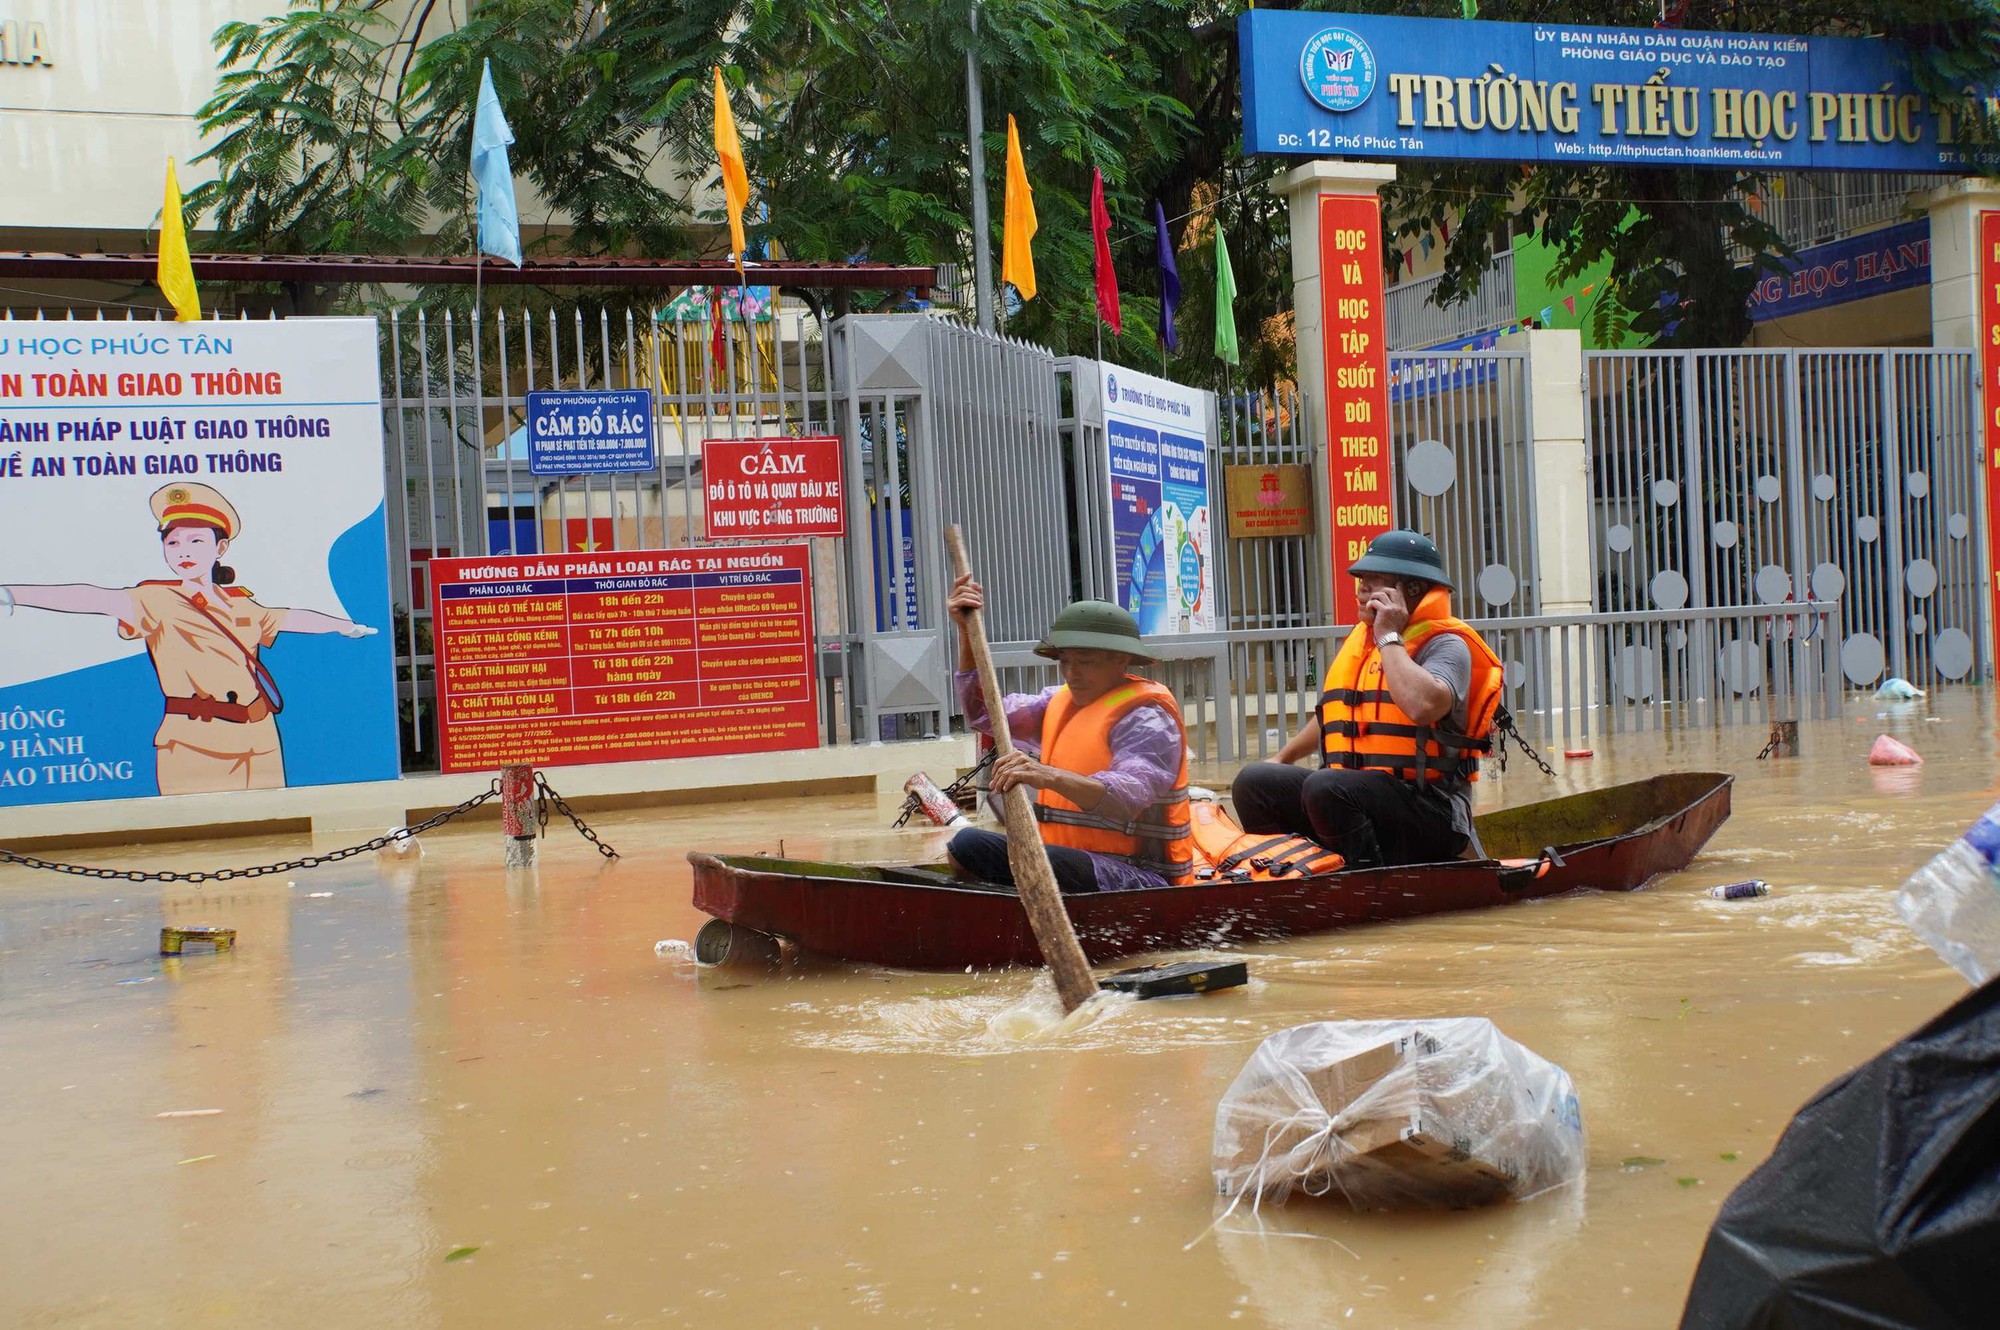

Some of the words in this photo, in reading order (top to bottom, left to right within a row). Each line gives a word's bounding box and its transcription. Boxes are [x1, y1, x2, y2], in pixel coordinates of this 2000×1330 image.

[1535, 26, 1556, 42] ỦY
[1561, 32, 1592, 44] BAN
[1597, 32, 1640, 46] NHÂN
[1645, 34, 1676, 47] DÂN
[1681, 36, 1723, 52] QUẬN
[1728, 38, 1769, 51] HOÀN
[1774, 38, 1808, 52] KIẾM
[1562, 46, 1614, 60] PHÒNG
[1619, 49, 1656, 62] GIÁO
[1661, 52, 1692, 66] DỤC
[1696, 53, 1716, 65] VÀ
[1721, 54, 1752, 66] ĐÀO
[1756, 56, 1786, 70] TẠO
[1388, 64, 1580, 134] TRƯỜNG
[1591, 67, 1699, 137] TIỂU
[1710, 88, 1798, 149] HỌC
[1806, 82, 1921, 144] PHÚC
[1278, 134, 1302, 146] ĐC:
[1307, 129, 1331, 147] 12
[1335, 134, 1360, 148] Phố
[1364, 136, 1396, 149] Phúc
[1399, 138, 1424, 150] Tân
[1554, 142, 1584, 155] Web:
[1335, 229, 1366, 255] ĐỌC
[1342, 263, 1363, 285] VÀ
[1788, 258, 1848, 299] HỌC
[1338, 298, 1369, 324] HỌC
[19, 337, 82, 359] HỌC
[92, 332, 169, 355] PHÚC
[178, 334, 232, 355] TÂN
[1340, 327, 1370, 358] TẬP
[31, 368, 107, 398] TOÀN
[117, 373, 182, 396] GIAO
[191, 367, 282, 395] THÔNG
[1337, 360, 1376, 389] SUỐT
[541, 397, 562, 406] UBND
[563, 395, 597, 405] PHƯỜNG
[598, 396, 619, 404] PHÚC
[621, 394, 637, 404] TÂN
[1344, 397, 1371, 424] ĐỜI
[57, 417, 122, 442] PHÁP
[130, 416, 187, 445] LUẬT
[194, 419, 248, 440] GIAO
[255, 415, 331, 439] THÔNG
[536, 407, 574, 437] CẤM
[578, 406, 603, 436] ĐỔ
[607, 408, 644, 435] RÁC
[1339, 436, 1379, 458] THEO
[31, 457, 66, 477] AN
[72, 451, 137, 477] TOÀN
[144, 454, 198, 476] GIAO
[205, 449, 282, 474] THÔNG
[1343, 464, 1378, 492] TẤM
[738, 481, 752, 500] TÔ
[754, 480, 769, 500] VÀ
[772, 483, 798, 501] QUAY
[825, 481, 839, 497] XE
[714, 510, 736, 527] KHU
[739, 510, 760, 529] VỰC
[795, 504, 838, 524] TRƯỜNG
[1336, 504, 1388, 527] GƯƠNG
[1348, 537, 1373, 561] BÁ
[459, 565, 518, 580] HƯỚNG
[524, 561, 560, 577] DẪN
[565, 561, 612, 576] PHÂN
[617, 560, 653, 575] LOẠI
[659, 558, 692, 572] RÁC
[696, 558, 722, 572] TẠI
[719, 575, 729, 586] VỊ
[730, 573, 742, 584] TRÍ
[755, 573, 771, 583] RÁC
[469, 585, 493, 595] PHÂN
[495, 585, 514, 596] LOẠI
[515, 583, 533, 593] RÁC
[594, 579, 615, 590] THỜI
[616, 579, 637, 589] GIAN
[651, 577, 668, 587] RÁC
[445, 606, 454, 616] 1.
[456, 602, 474, 616] RÁC
[476, 602, 495, 615] THẢI
[498, 601, 510, 614] CÓ
[530, 600, 544, 612] TÁI
[546, 598, 563, 611] CHẾ
[598, 596, 618, 607] 18h
[621, 592, 641, 606] đến
[644, 593, 664, 605] 22h
[446, 636, 455, 645] 2.
[458, 631, 482, 645] CHẤT
[483, 630, 504, 643] THẢI
[605, 628, 618, 638] 7h
[621, 625, 641, 637] đến
[644, 626, 664, 636] 10h
[448, 668, 457, 678] 3.
[459, 664, 482, 677] CHẤT
[484, 662, 504, 676] THẢI
[506, 664, 530, 675] NGUY
[532, 663, 547, 676] HẠI
[608, 657, 628, 668] 18h
[631, 654, 651, 667] đến
[653, 655, 674, 666] 22h
[450, 699, 460, 709] 4.
[463, 695, 489, 709] CHẤT
[490, 693, 513, 706] THẢI
[516, 692, 537, 705] CÒN
[539, 693, 554, 706] LẠI
[611, 693, 630, 704] 18h
[633, 690, 653, 703] đến
[655, 691, 676, 701] 22h
[10, 732, 86, 759] HÀNH
[42, 756, 135, 785] THÔNG
